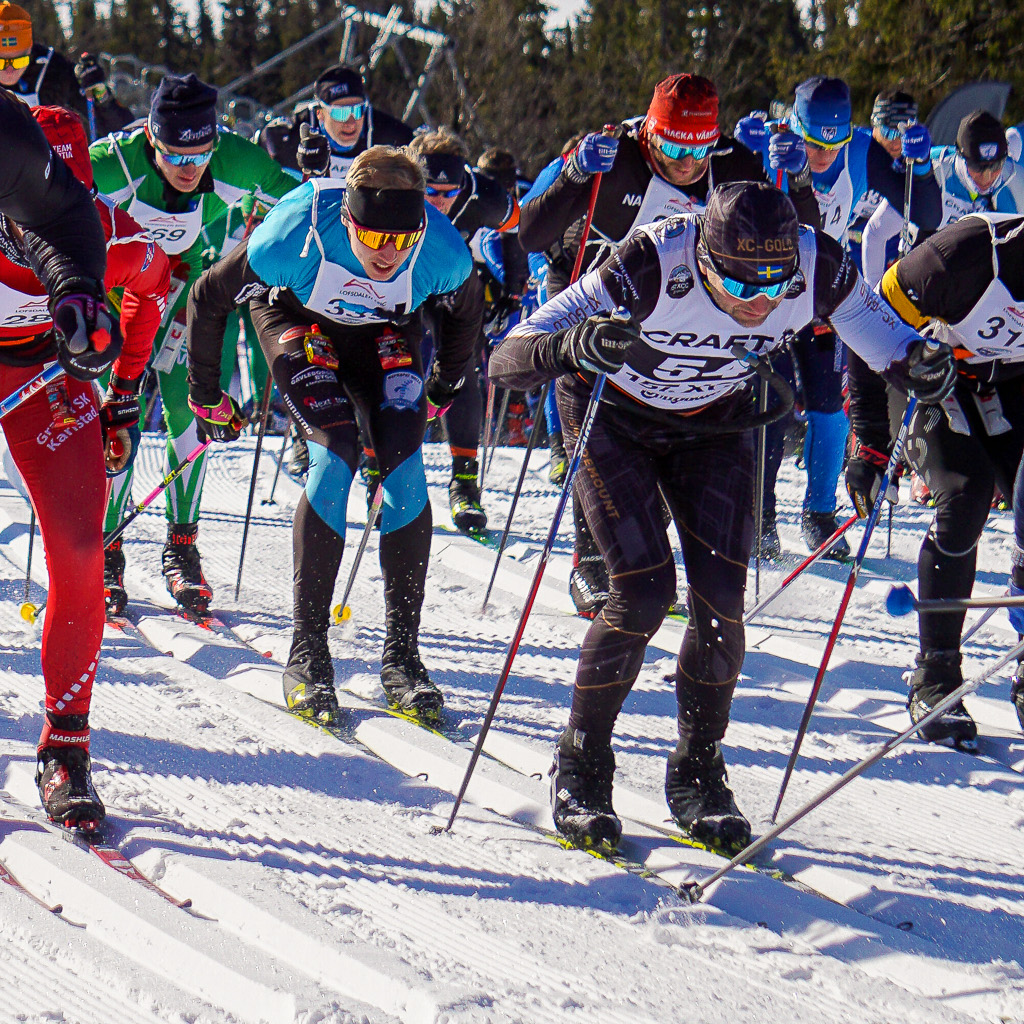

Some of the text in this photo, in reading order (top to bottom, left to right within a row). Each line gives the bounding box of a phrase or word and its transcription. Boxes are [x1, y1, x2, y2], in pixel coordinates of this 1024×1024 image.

[662, 128, 694, 141] NACKA
[736, 237, 795, 253] XC-GOLD
[641, 330, 775, 350] CRAFT
[977, 316, 1024, 349] 31
[567, 418, 621, 519] SWDEMOUNT
[48, 733, 90, 743] MADSHUS
